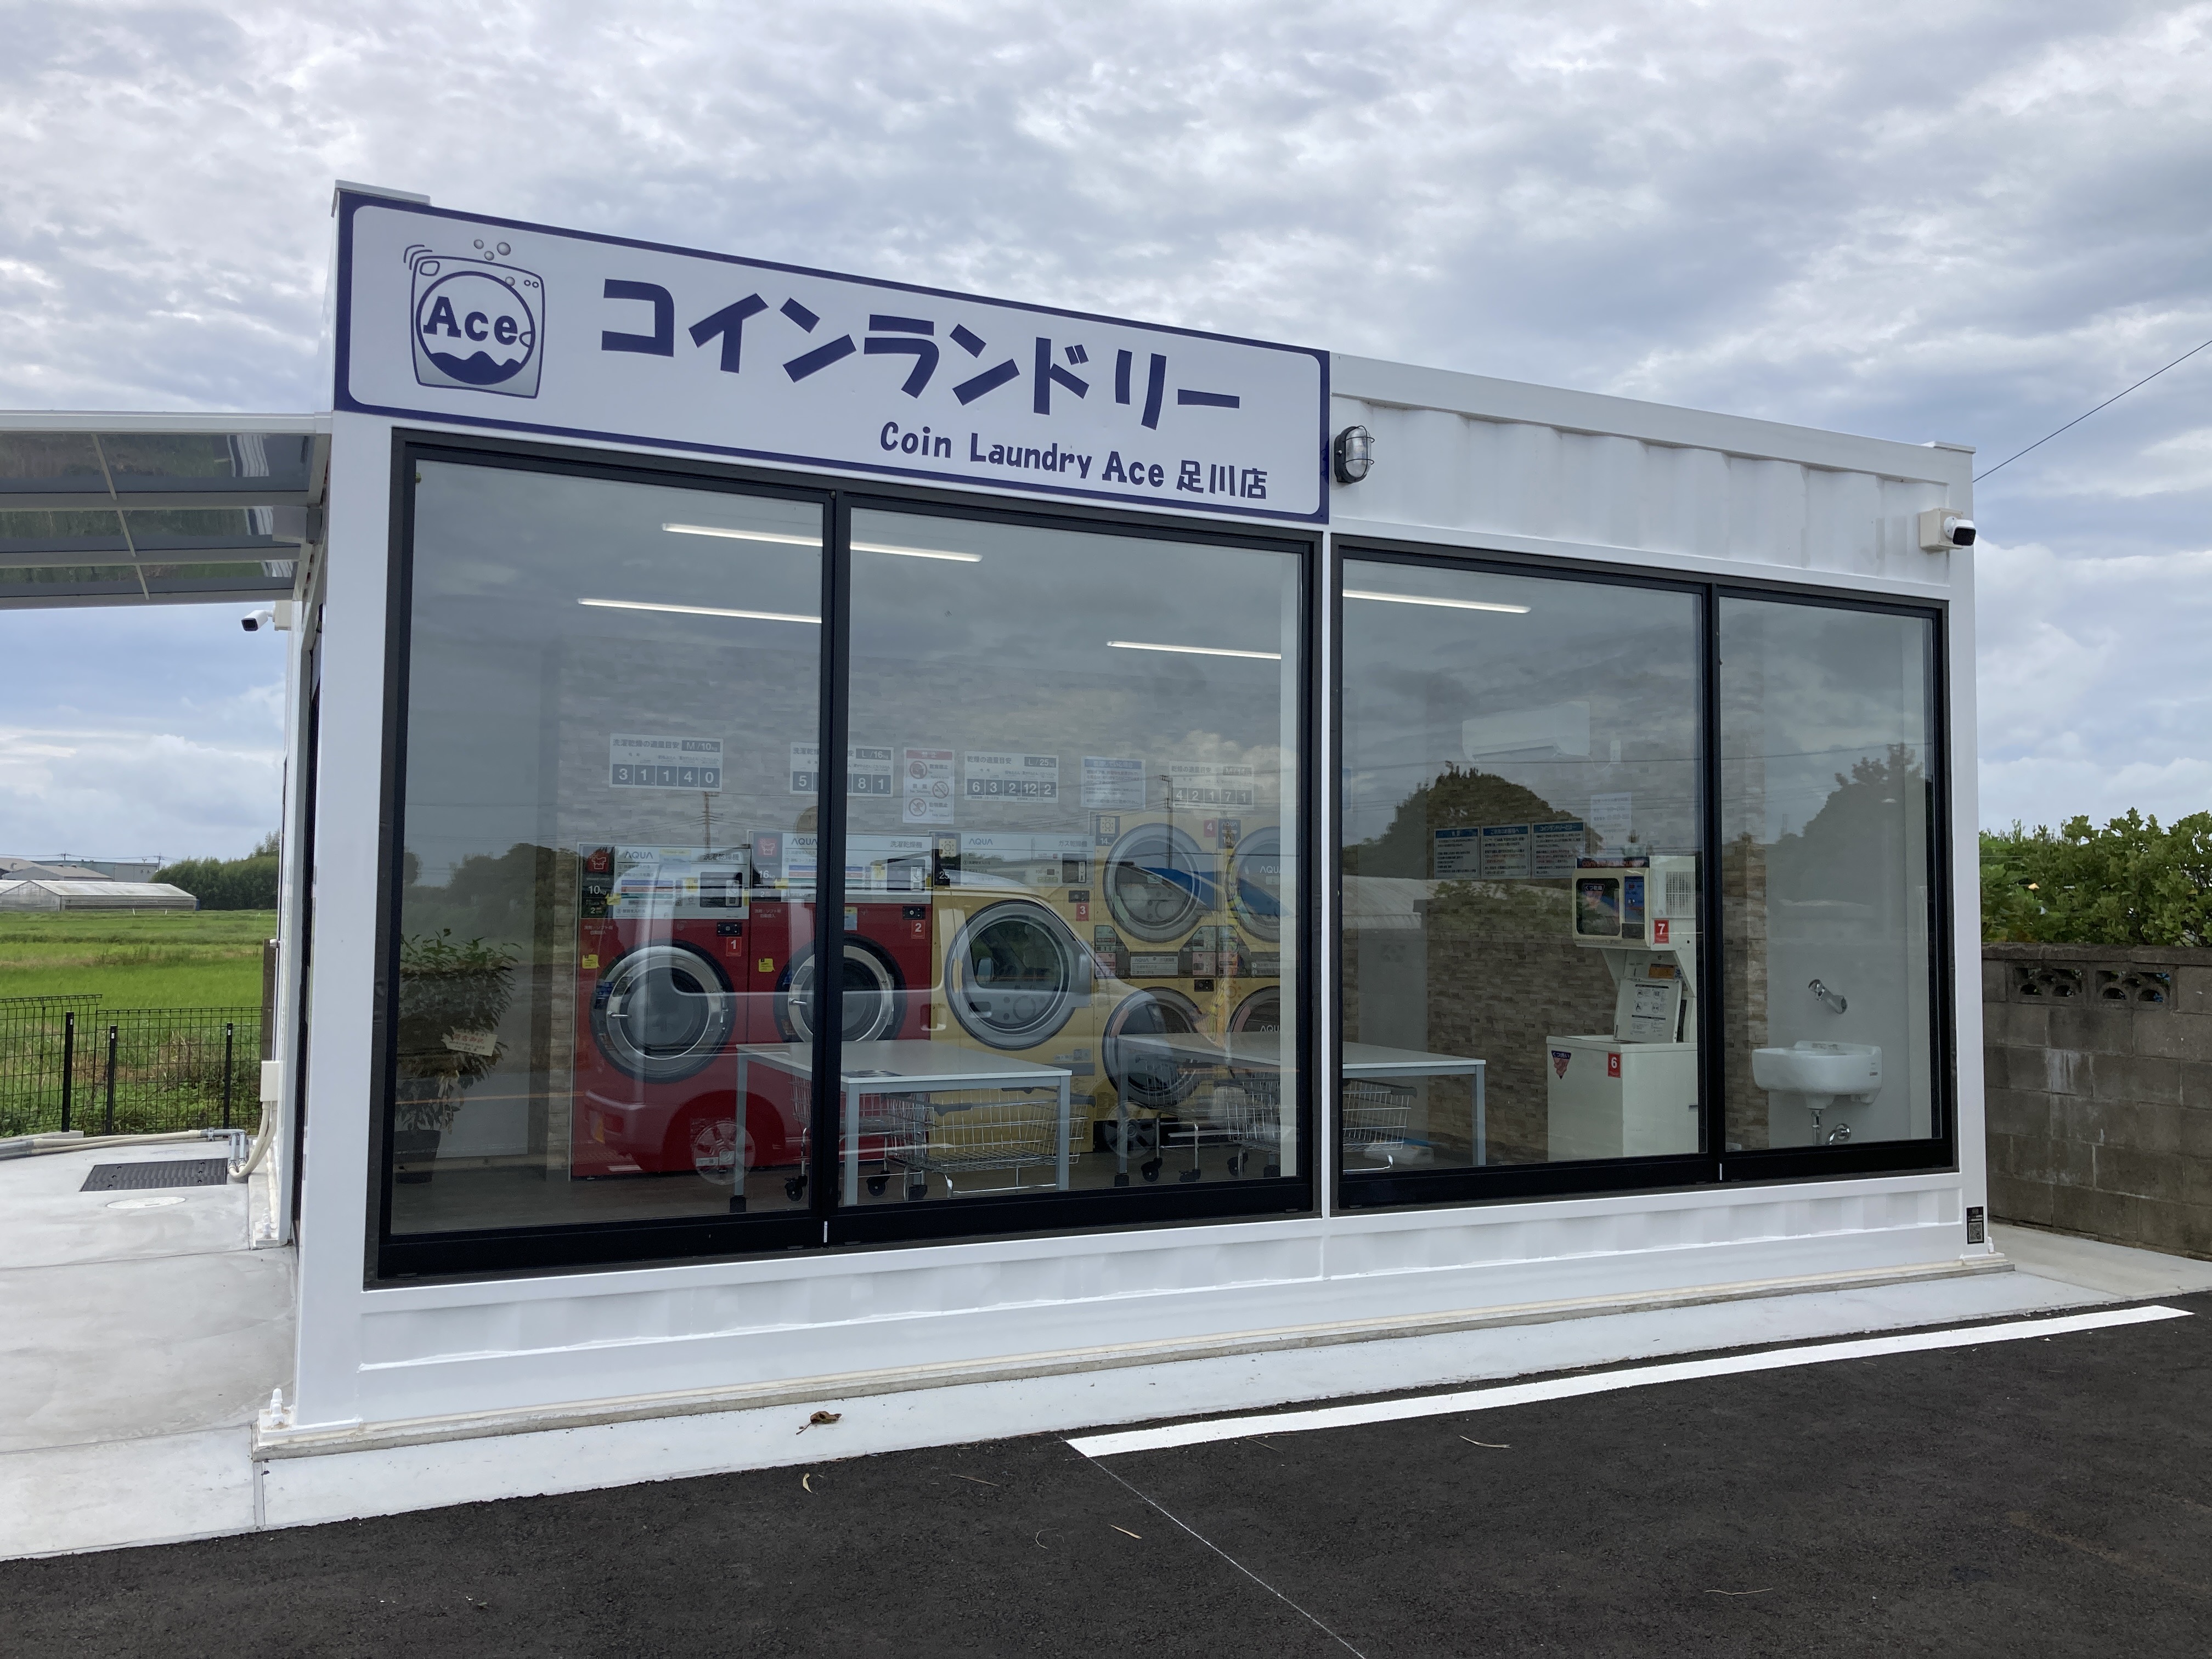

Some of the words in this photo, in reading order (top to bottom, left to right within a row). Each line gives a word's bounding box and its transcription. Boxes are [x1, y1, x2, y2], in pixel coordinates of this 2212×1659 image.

[423, 295, 518, 346] Ace
[602, 279, 1240, 429] コインランドリー
[881, 421, 951, 458] Coin
[970, 432, 1092, 479] Laundry
[1102, 450, 1165, 488] Ace
[1177, 460, 1267, 500] 足川店
[619, 768, 628, 780] 3
[640, 769, 647, 781] 1
[663, 770, 669, 782] 1
[684, 771, 693, 783] 4
[705, 771, 714, 783] 0
[798, 775, 807, 787] 5
[857, 777, 866, 789] 8
[878, 778, 884, 789] 1
[972, 781, 980, 793] 6
[989, 782, 997, 793] 3
[1008, 782, 1017, 794] 2
[1023, 783, 1037, 794] 12
[1043, 784, 1052, 795] 2
[1176, 789, 1183, 800] 4
[1192, 790, 1199, 801] 2
[1209, 791, 1214, 802] 1
[1225, 791, 1232, 802] 7
[1241, 792, 1246, 803] 1
[1206, 822, 1213, 831] 4
[890, 840, 923, 849] 洗濯乾燥機
[624, 851, 653, 860] AQUA
[1259, 866, 1280, 874] AQU
[588, 885, 607, 895] 10kg
[1079, 906, 1086, 915] 3
[915, 923, 922, 932] 2
[1658, 923, 1666, 935] 7
[731, 939, 737, 950] 1
[1611, 1057, 1618, 1069] 6
